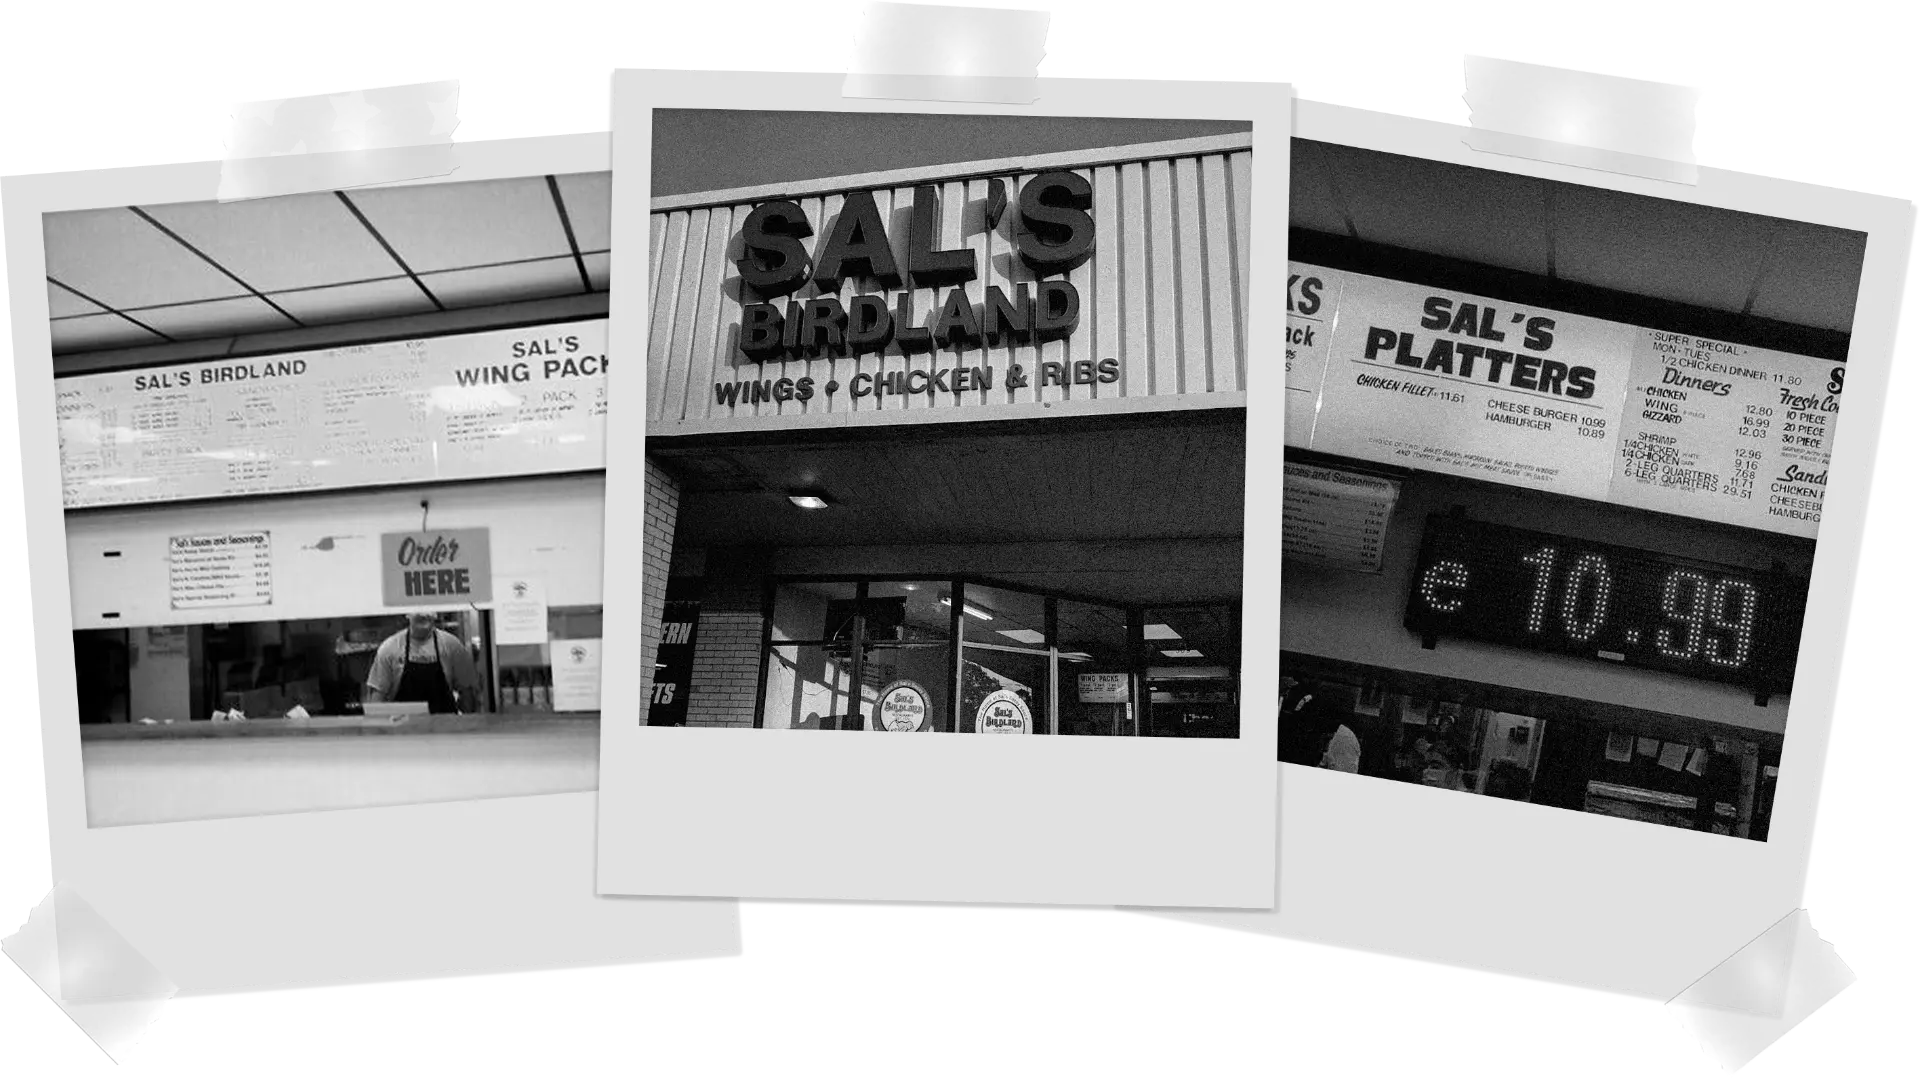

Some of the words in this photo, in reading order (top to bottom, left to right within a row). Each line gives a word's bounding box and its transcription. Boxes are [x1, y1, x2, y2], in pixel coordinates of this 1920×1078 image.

[736, 171, 1096, 299] SAL'S
[740, 280, 1080, 362] BIRDLAND
[1420, 296, 1556, 352] SAL'S
[512, 336, 579, 358] SAL'S
[1653, 342, 1677, 353] MON
[1685, 347, 1711, 361] TUES
[1654, 332, 1689, 346] SUPER
[1695, 340, 1740, 356] SPECIAL
[134, 371, 191, 392] SAL'S
[201, 360, 306, 384] BIRDLAND
[456, 363, 530, 388] WING
[1364, 326, 1596, 400] PLATTERS
[1661, 355, 1677, 366] 1/2
[1679, 358, 1727, 374] CHICKEN
[1729, 366, 1767, 381] DINNER
[1772, 374, 1802, 386] 11.80
[716, 376, 814, 405] WINGS
[850, 366, 993, 398] CHICKEN
[1006, 363, 1028, 389] &
[1042, 358, 1120, 386] RIBS
[1356, 373, 1400, 392] CHICKEN
[1401, 378, 1434, 398] FILLET
[1646, 386, 1688, 401] CHICKEN
[1662, 367, 1732, 396] Dinners
[1487, 399, 1530, 416] CHEESE
[1533, 404, 1578, 424] BURGER
[1580, 416, 1606, 429] 10.99
[1645, 399, 1678, 413] WING
[1742, 416, 1770, 428] 16.99
[1746, 405, 1773, 417] 12.80
[1779, 388, 1818, 412] Fresh
[1820, 395, 1840, 414] Co
[1486, 412, 1552, 432] HAMBURGER
[1577, 426, 1605, 440] 10.89
[1642, 410, 1682, 425] GIZZARD
[1738, 427, 1766, 439] 12.03
[1782, 422, 1796, 432] 20
[1798, 424, 1825, 437] PIECE
[1786, 410, 1797, 421] 10
[1800, 412, 1827, 426] PIECE
[1638, 431, 1677, 445] SHRIMP
[1734, 448, 1762, 460] 12.96
[1782, 434, 1795, 444] 30
[1796, 436, 1822, 449] PIECE
[1625, 458, 1659, 473] 2-LEG
[1662, 465, 1719, 484] QUARTERS
[1730, 477, 1754, 489] 11.71
[1734, 459, 1758, 470] 9.16
[1735, 469, 1756, 480] 7.68
[1776, 464, 1828, 486] Sand
[1624, 468, 1656, 481] 6-LEG
[1661, 474, 1718, 492] QUARTERS
[1723, 485, 1752, 500] 29.51
[1771, 483, 1820, 499] CHICKEN
[398, 536, 459, 566] Order
[404, 568, 470, 596] HERE
[1422, 560, 1470, 611] e
[1522, 548, 1756, 666] 10.99
